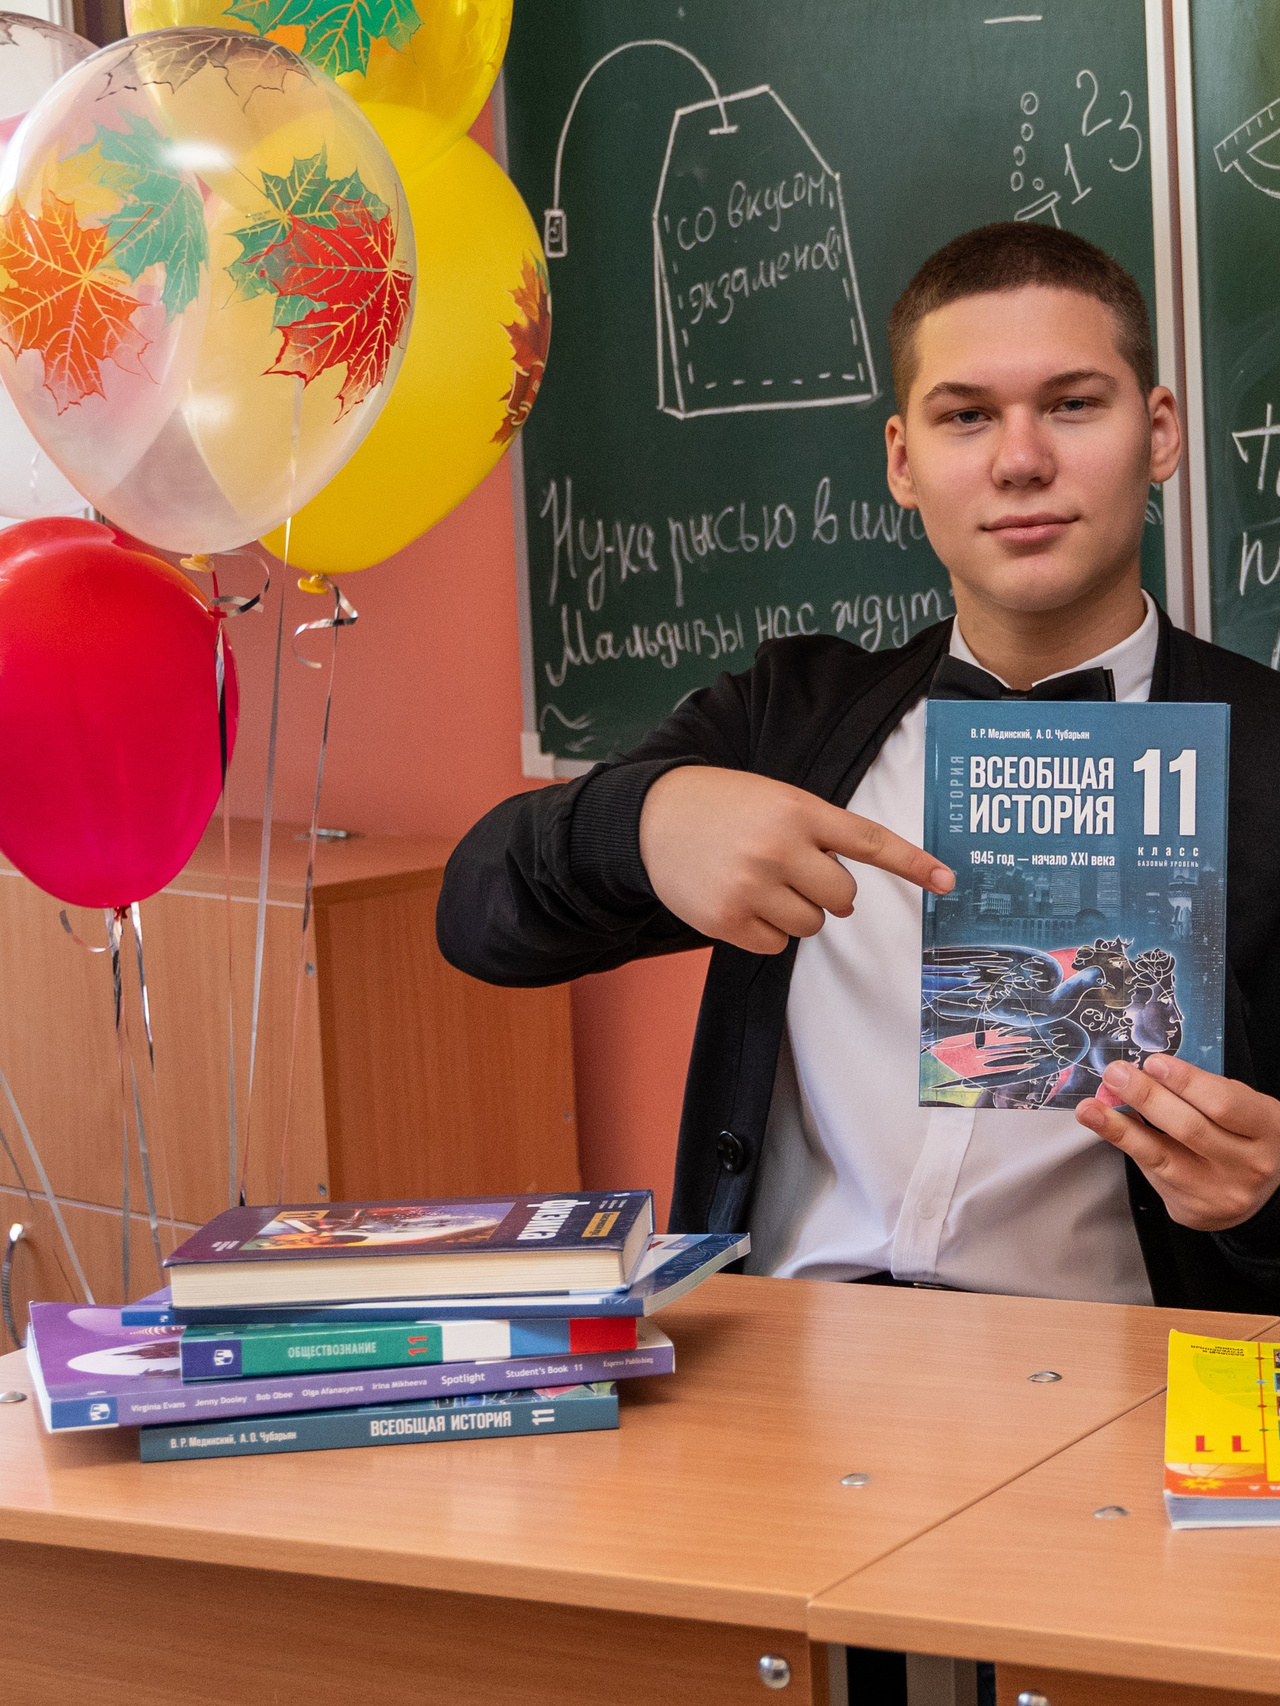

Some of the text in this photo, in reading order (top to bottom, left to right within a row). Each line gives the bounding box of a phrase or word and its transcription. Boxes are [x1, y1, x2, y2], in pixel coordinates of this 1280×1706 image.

[970, 728, 1090, 741] В. Р. Мединский, А. О. Чубарьян
[949, 755, 965, 834] ИСТОРИЯ
[969, 755, 1115, 795] ВСЕОБЩАЯ
[1133, 748, 1198, 836] 11
[969, 794, 1115, 836] ИСТОРИЯ
[969, 850, 994, 865] 1945
[996, 853, 1015, 867] год
[1031, 853, 1068, 866] начало
[1070, 851, 1089, 866] XXI
[1091, 854, 1116, 867] века
[1137, 859, 1199, 868] БАЗОВЫЙ УРОВЕНЬ
[288, 1335, 428, 1359] ОБЩЕСТВОЗНАНИЕ 11
[131, 1403, 161, 1413] Virginia
[163, 1401, 186, 1410] Evans
[195, 1397, 218, 1408] Jenny
[220, 1394, 248, 1406] Dooley
[256, 1392, 271, 1401] Bob
[273, 1390, 293, 1400] Obee
[302, 1387, 320, 1398] Olga
[320, 1384, 364, 1397] Afanasyeva
[372, 1381, 390, 1390] Irina
[391, 1378, 428, 1389] Mikheeva
[441, 1371, 486, 1386] Spotlight
[505, 1366, 546, 1378] Student's
[547, 1364, 569, 1375] Book
[573, 1363, 584, 1372] 11
[188, 1433, 236, 1448] Мединский,
[260, 1429, 297, 1443] Чубарьян
[370, 1414, 446, 1437] ВСЕОБЩАЯ
[450, 1410, 512, 1431] ИСТОРИЯ
[532, 1408, 555, 1427] 11
[1195, 1434, 1251, 1453] 11
